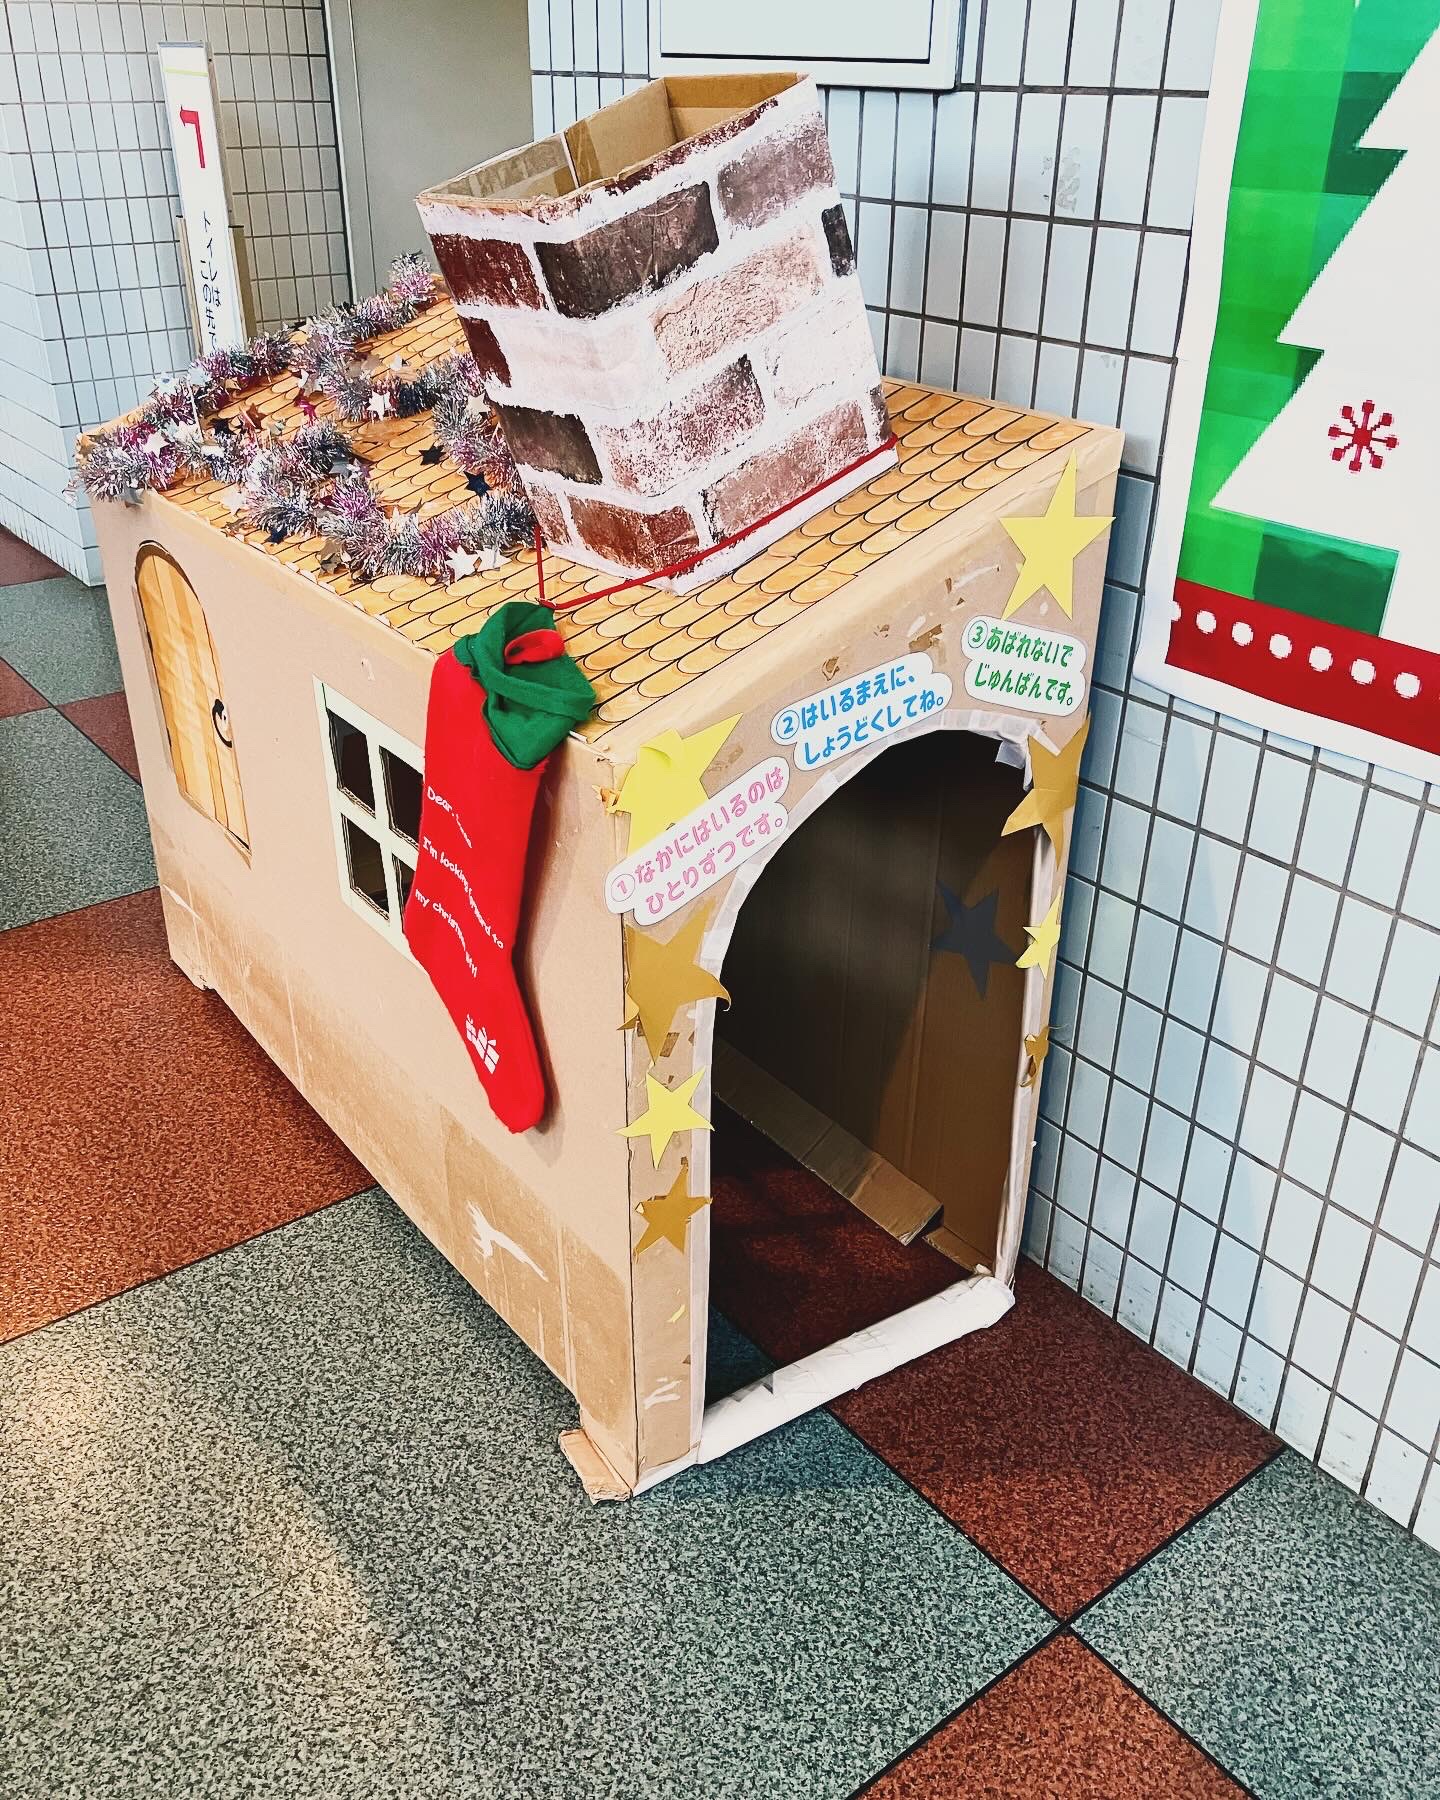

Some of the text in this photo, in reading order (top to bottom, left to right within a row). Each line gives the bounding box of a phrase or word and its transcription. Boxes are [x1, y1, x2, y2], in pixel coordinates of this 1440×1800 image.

[974, 662, 1073, 706] じゅんばんです。
[803, 690, 944, 765] しょうどくしてね。
[646, 812, 783, 914] ひとりずつです。
[415, 888, 430, 908] my
[491, 933, 504, 949] to
